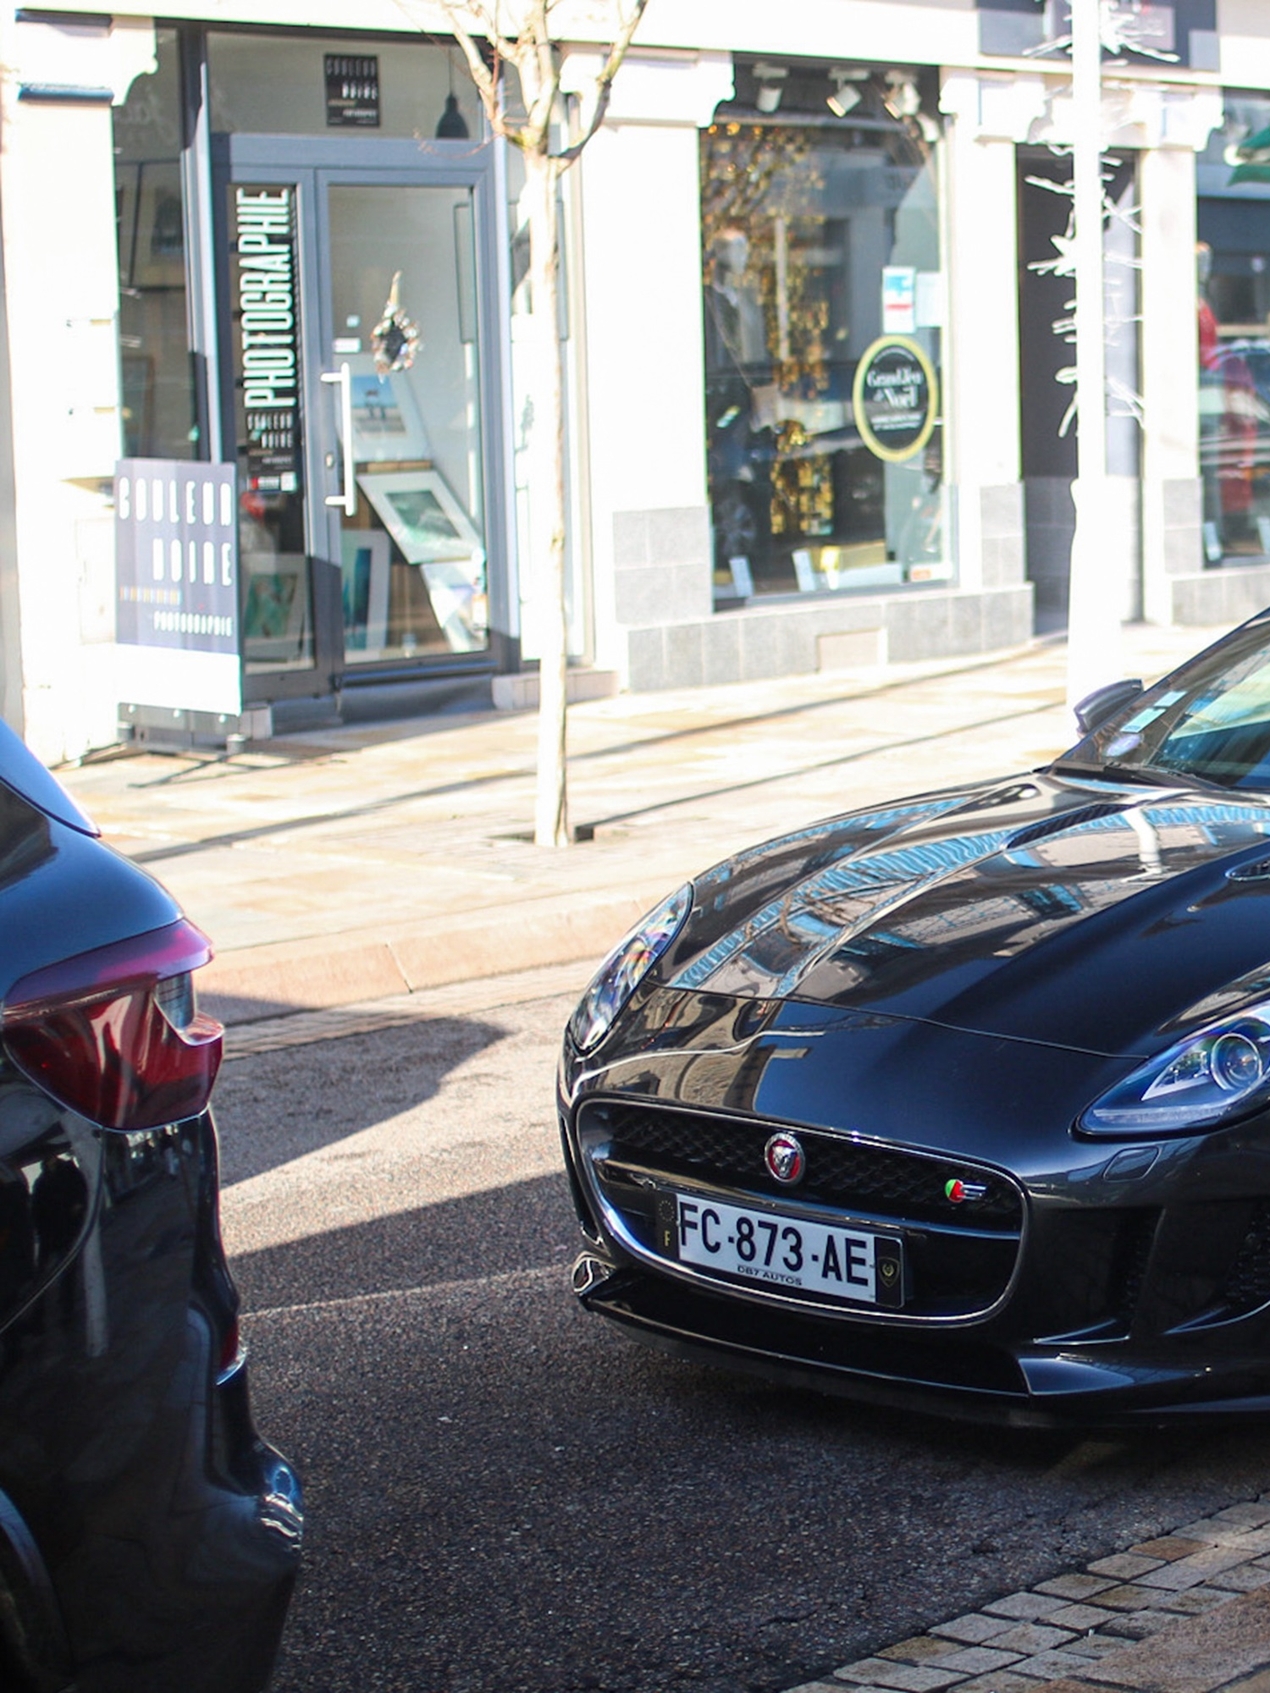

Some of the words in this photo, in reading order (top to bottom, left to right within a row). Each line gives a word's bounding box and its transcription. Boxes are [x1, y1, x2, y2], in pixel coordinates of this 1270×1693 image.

[236, 187, 297, 409] PHOTOGRAPHIE
[118, 476, 233, 527] COULEUR
[152, 537, 233, 588] NOIRE
[762, 1271, 803, 1286] AUTOS
